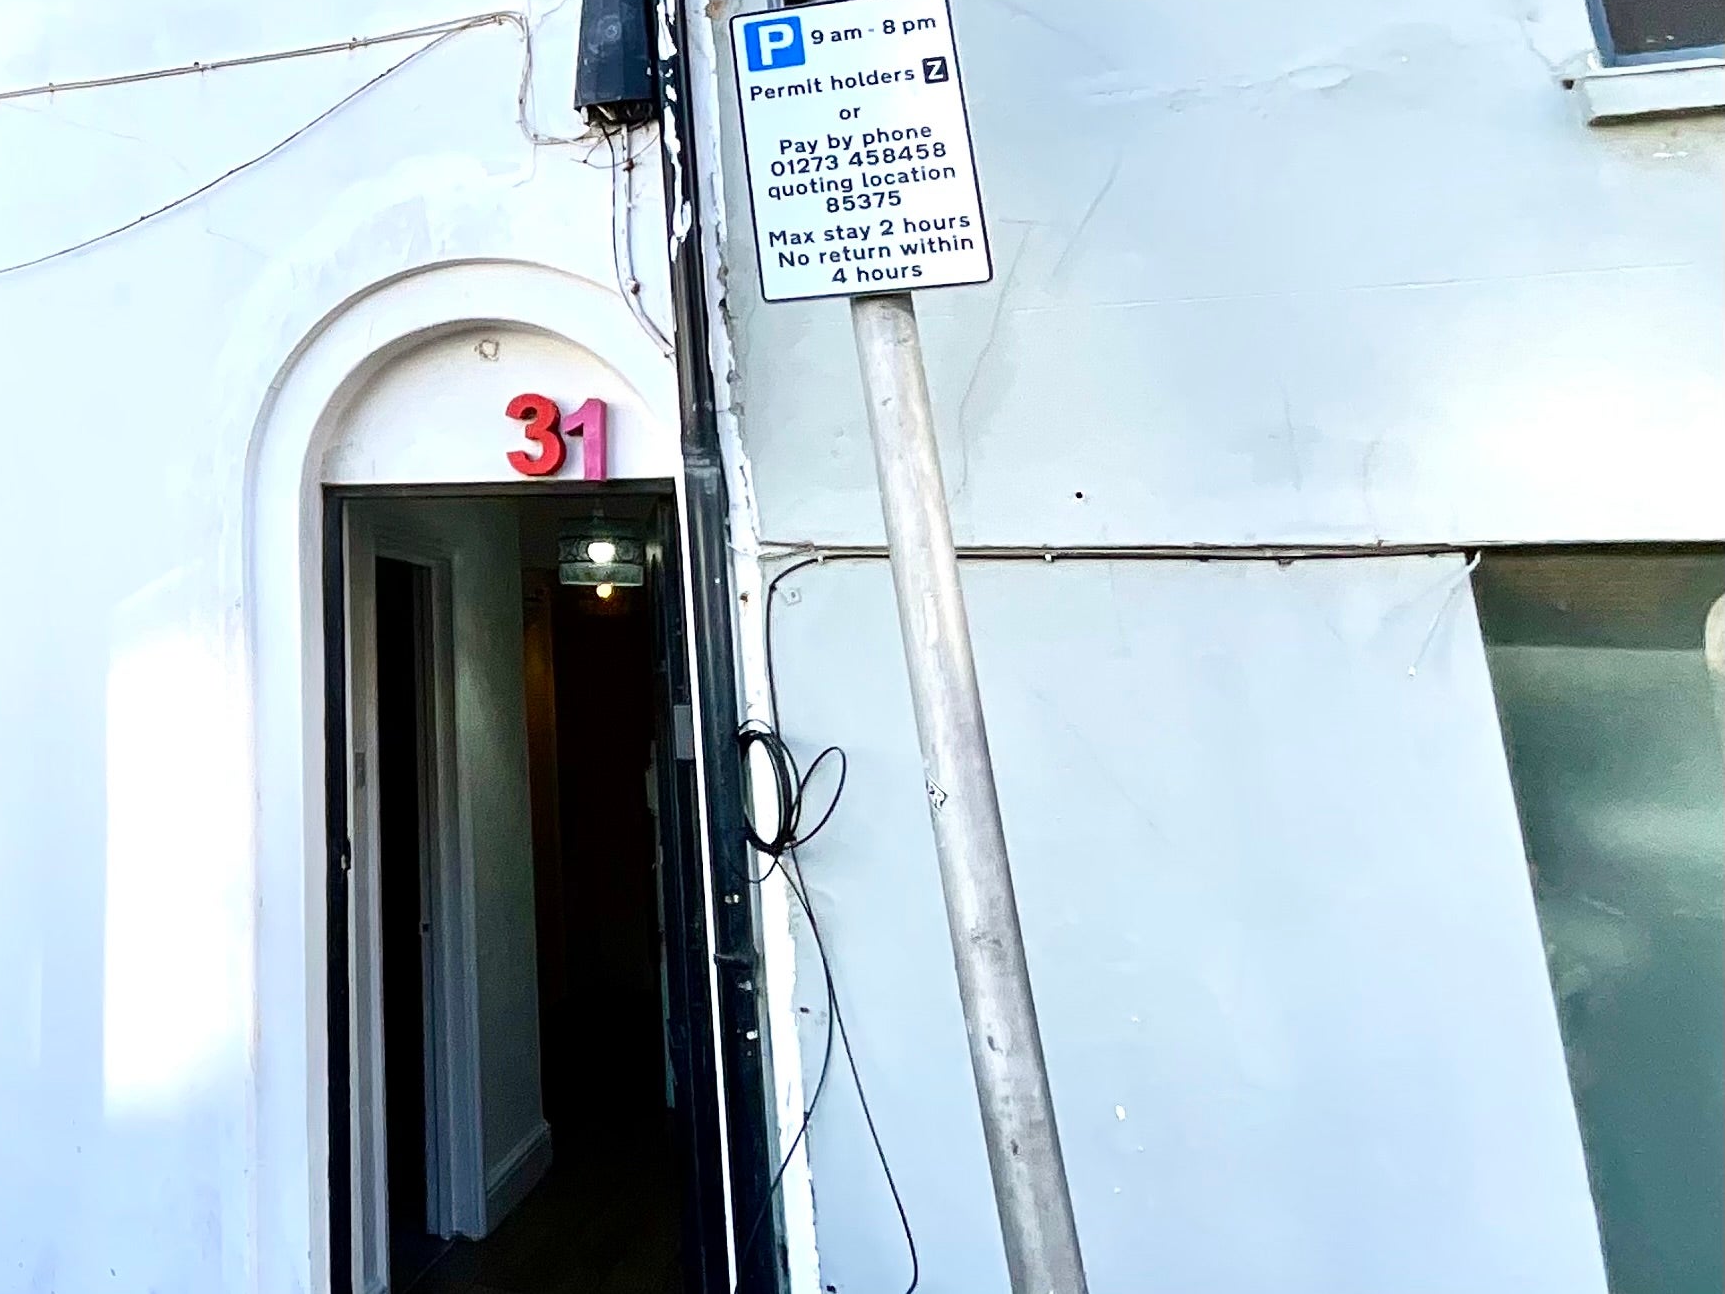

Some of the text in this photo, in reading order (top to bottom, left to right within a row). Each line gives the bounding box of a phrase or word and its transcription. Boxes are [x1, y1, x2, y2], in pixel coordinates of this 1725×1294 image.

[757, 23, 795, 66] P
[812, 30, 823, 44] 9
[831, 28, 862, 42] am
[883, 20, 895, 34] 8
[903, 18, 936, 34] pm
[750, 60, 944, 101] Permit holders Z
[840, 107, 860, 120] or
[780, 127, 931, 155] Pay by phone
[771, 142, 946, 176] 01273 458458
[769, 166, 955, 199] quoting location
[827, 190, 901, 213] 85375
[769, 216, 970, 247] Max stay 2 hours
[779, 237, 973, 267] No return within
[832, 265, 922, 283] 4 hours
[505, 393, 607, 482] 31
